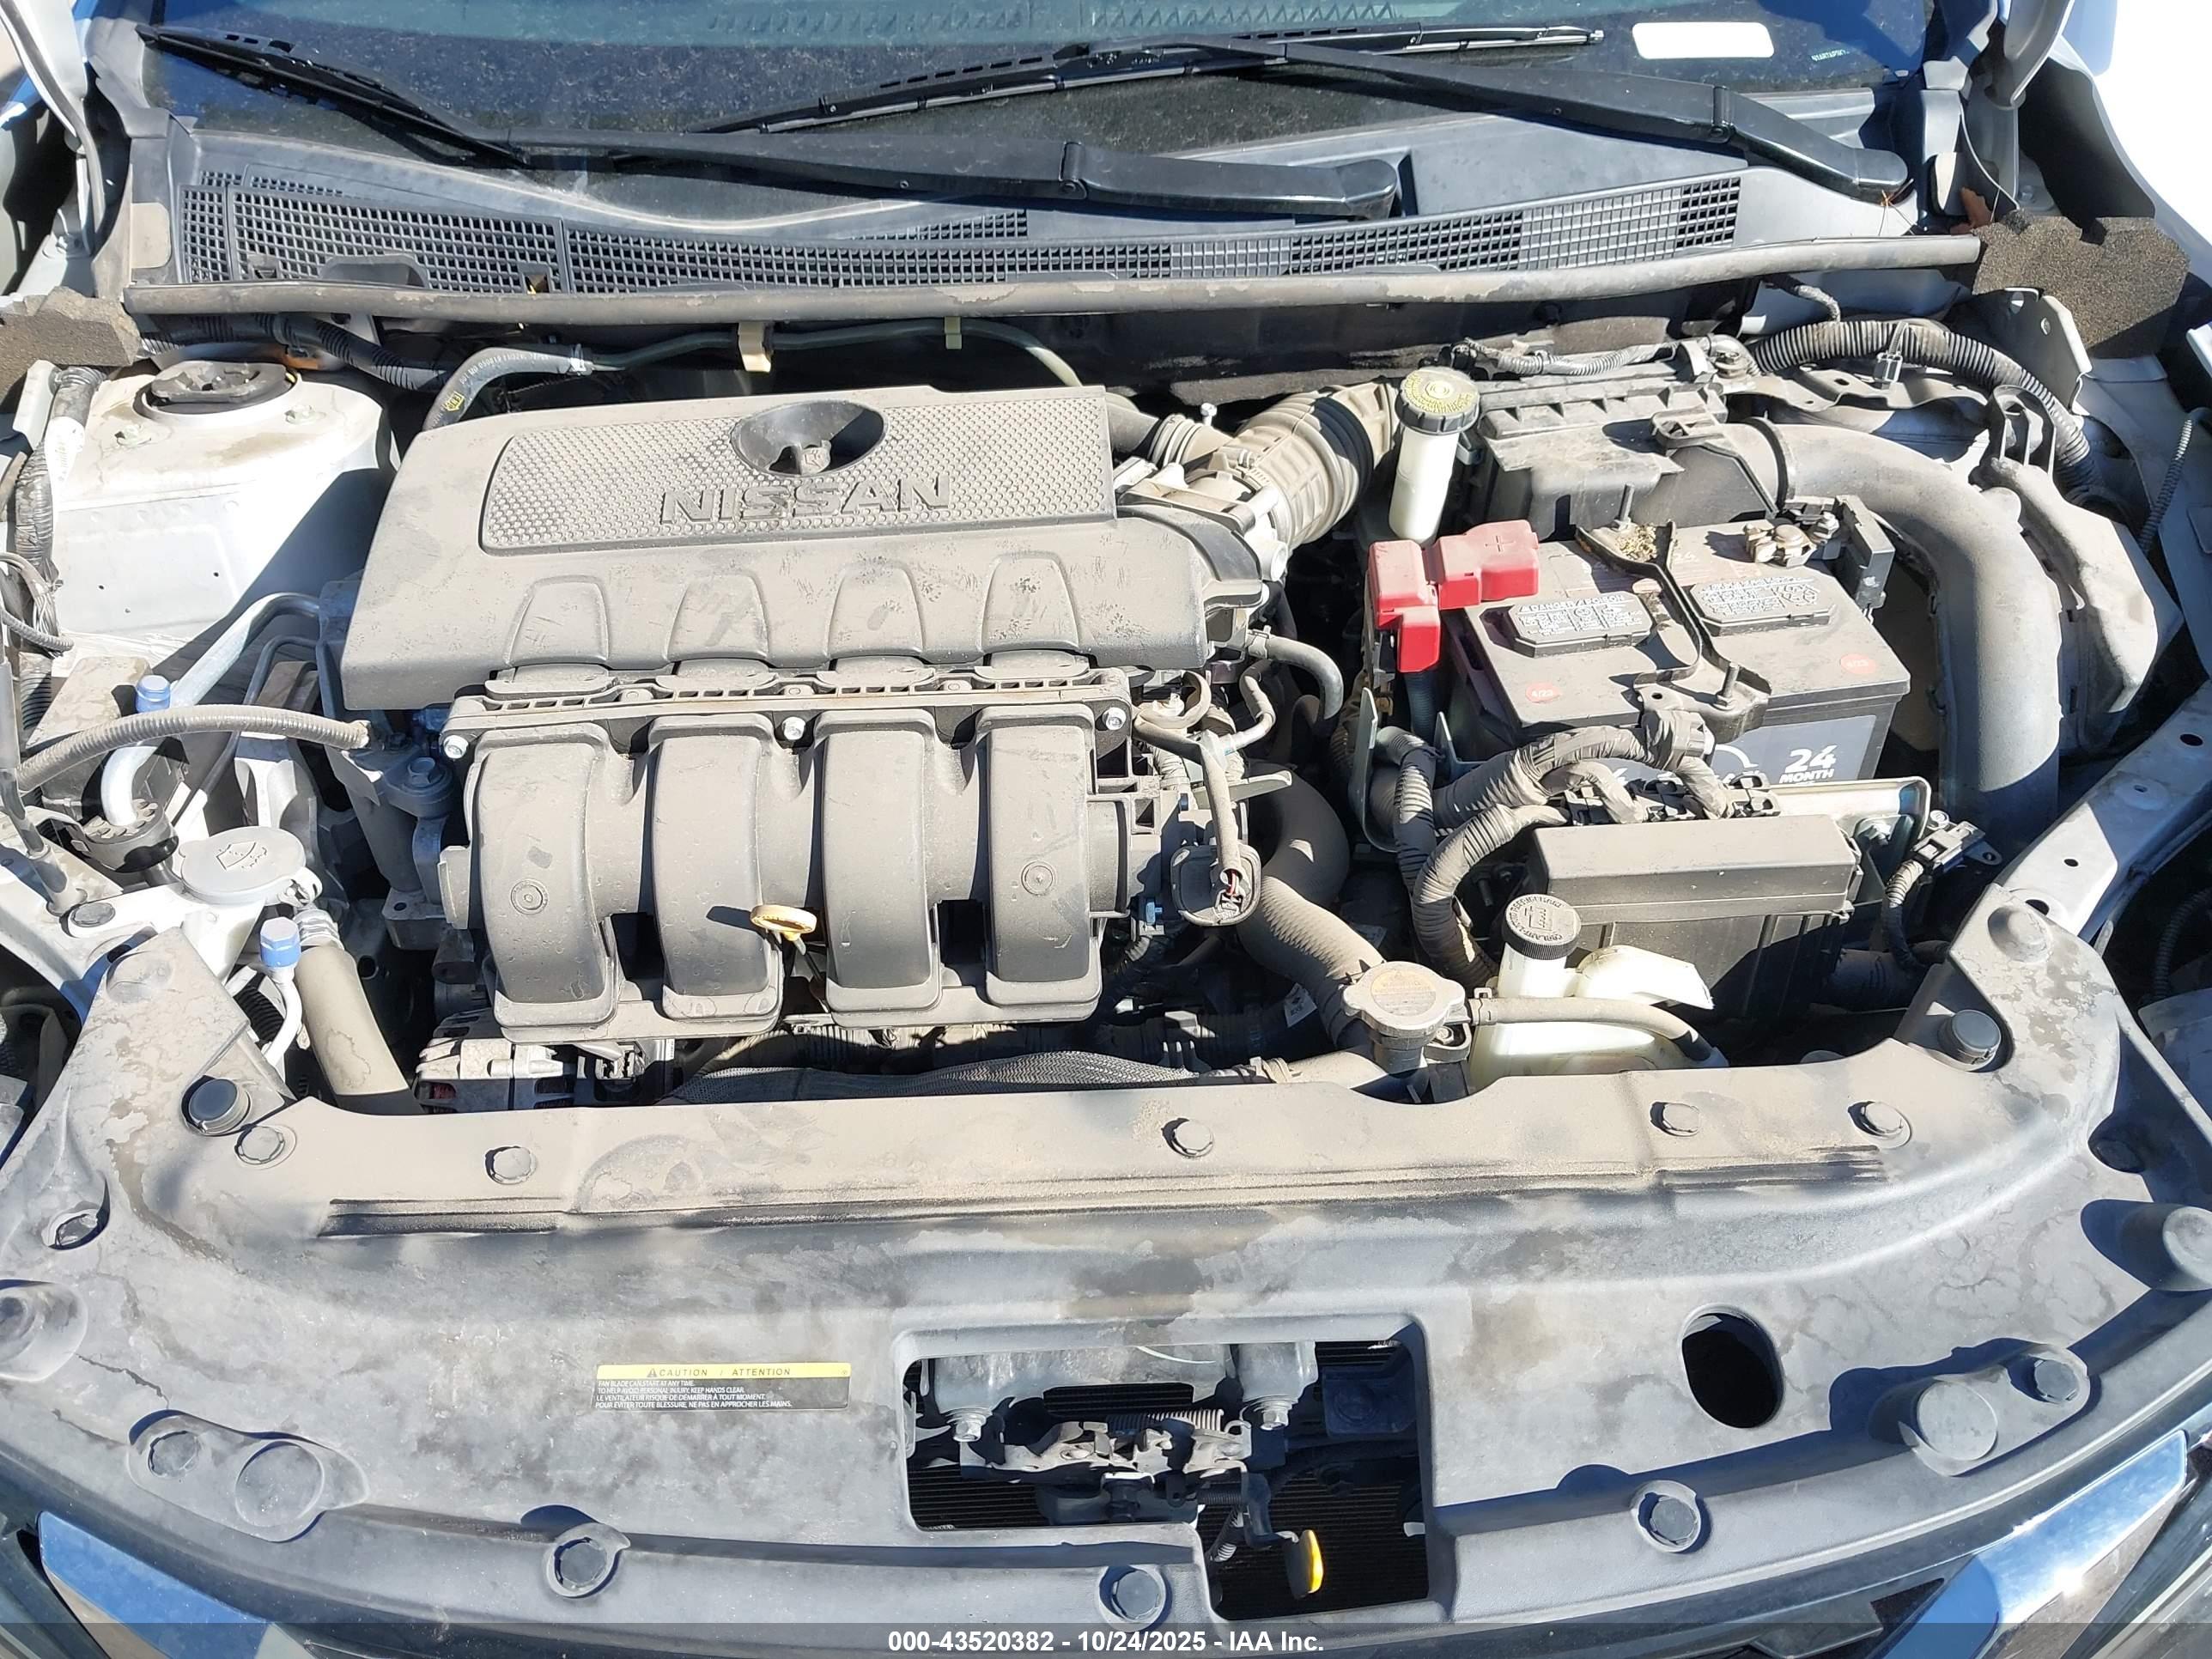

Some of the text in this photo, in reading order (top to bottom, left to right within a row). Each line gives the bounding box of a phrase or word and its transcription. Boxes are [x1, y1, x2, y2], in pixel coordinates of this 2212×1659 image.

[659, 471, 950, 525] NISSAN
[1784, 744, 1838, 773] 24
[1778, 768, 1836, 784] MONTH
[659, 1369, 708, 1377] CAUTION
[732, 1368, 791, 1376] ATTENTION
